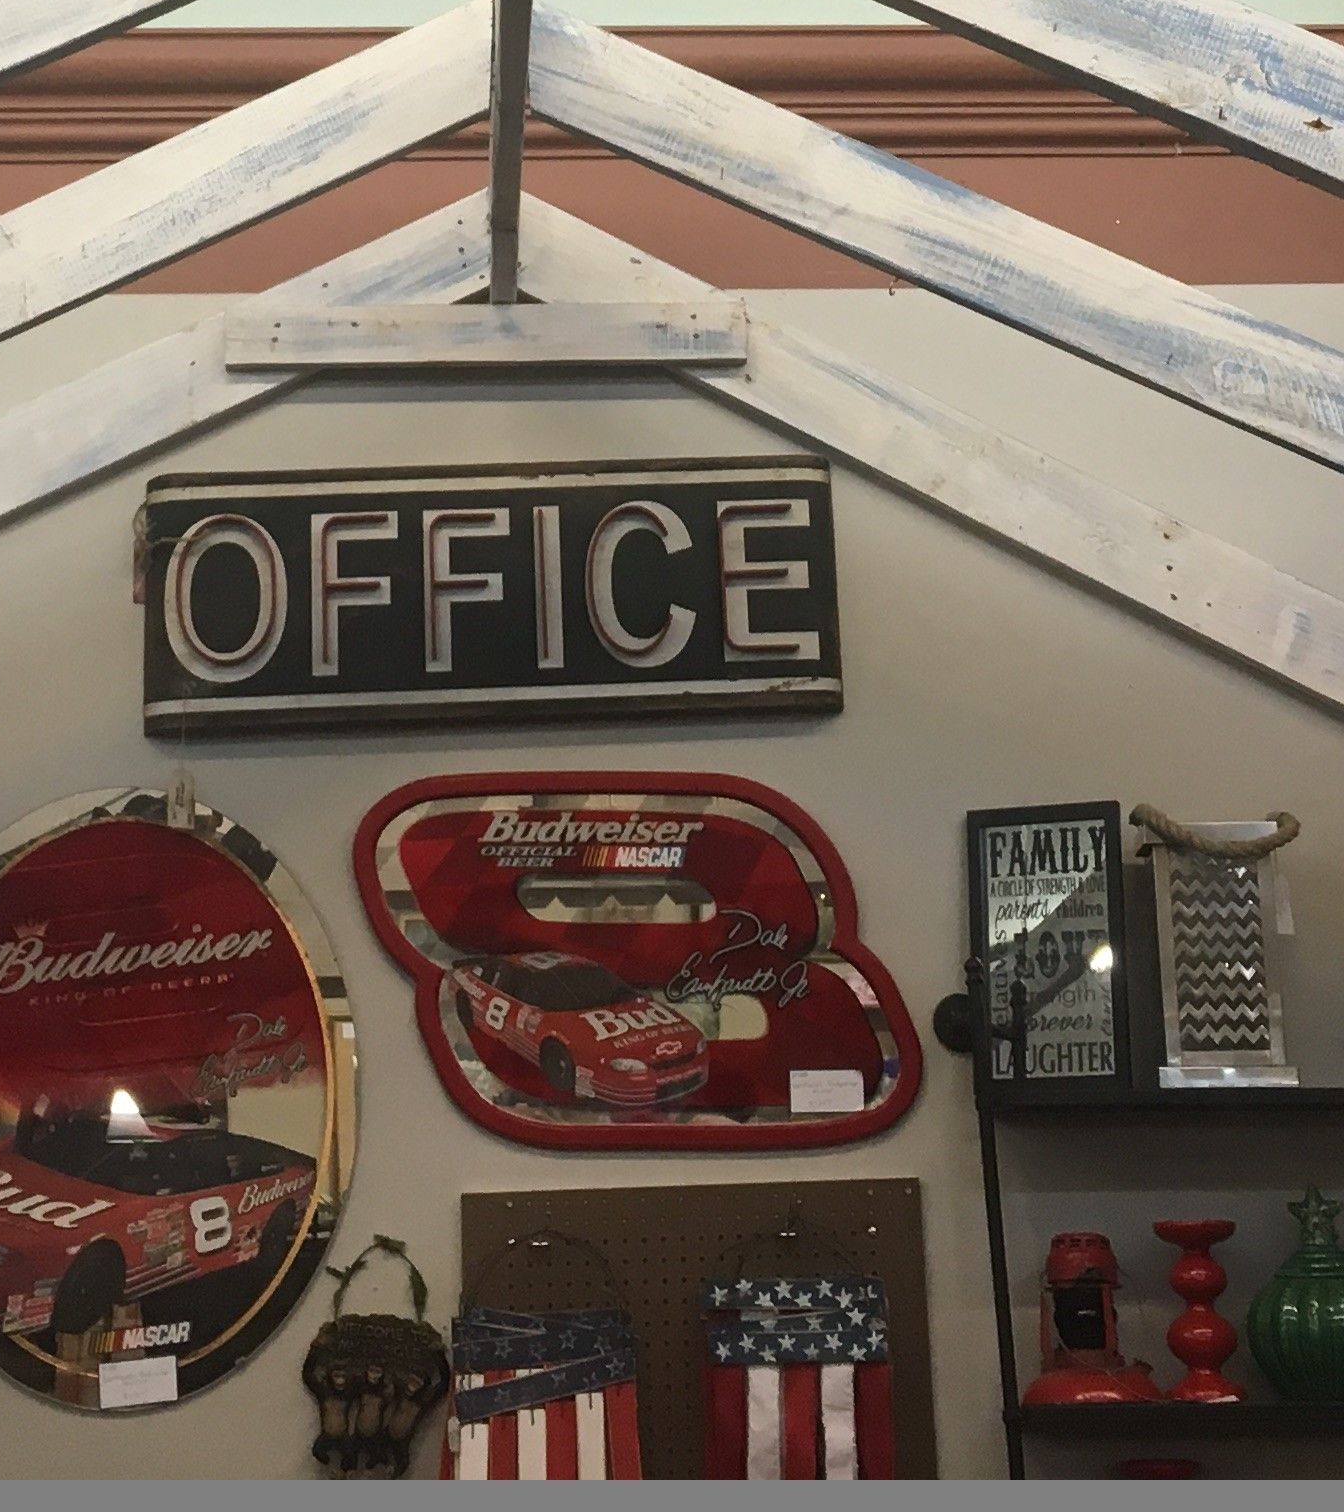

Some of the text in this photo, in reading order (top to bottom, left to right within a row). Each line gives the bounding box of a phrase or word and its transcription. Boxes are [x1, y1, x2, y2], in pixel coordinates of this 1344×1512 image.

[164, 498, 821, 683] OFFICE
[478, 810, 705, 844] Budweiser
[480, 845, 578, 858] OFFICIAL
[496, 857, 556, 868] BEER
[614, 846, 684, 868] NASCAR
[988, 826, 1108, 878] FAMILY
[709, 908, 789, 964] Dale
[484, 997, 511, 1031] 8
[579, 1001, 681, 1041] Bud
[1025, 1013, 1095, 1032] orever
[189, 1195, 233, 1254] 8
[121, 1320, 192, 1351] NASCAR
